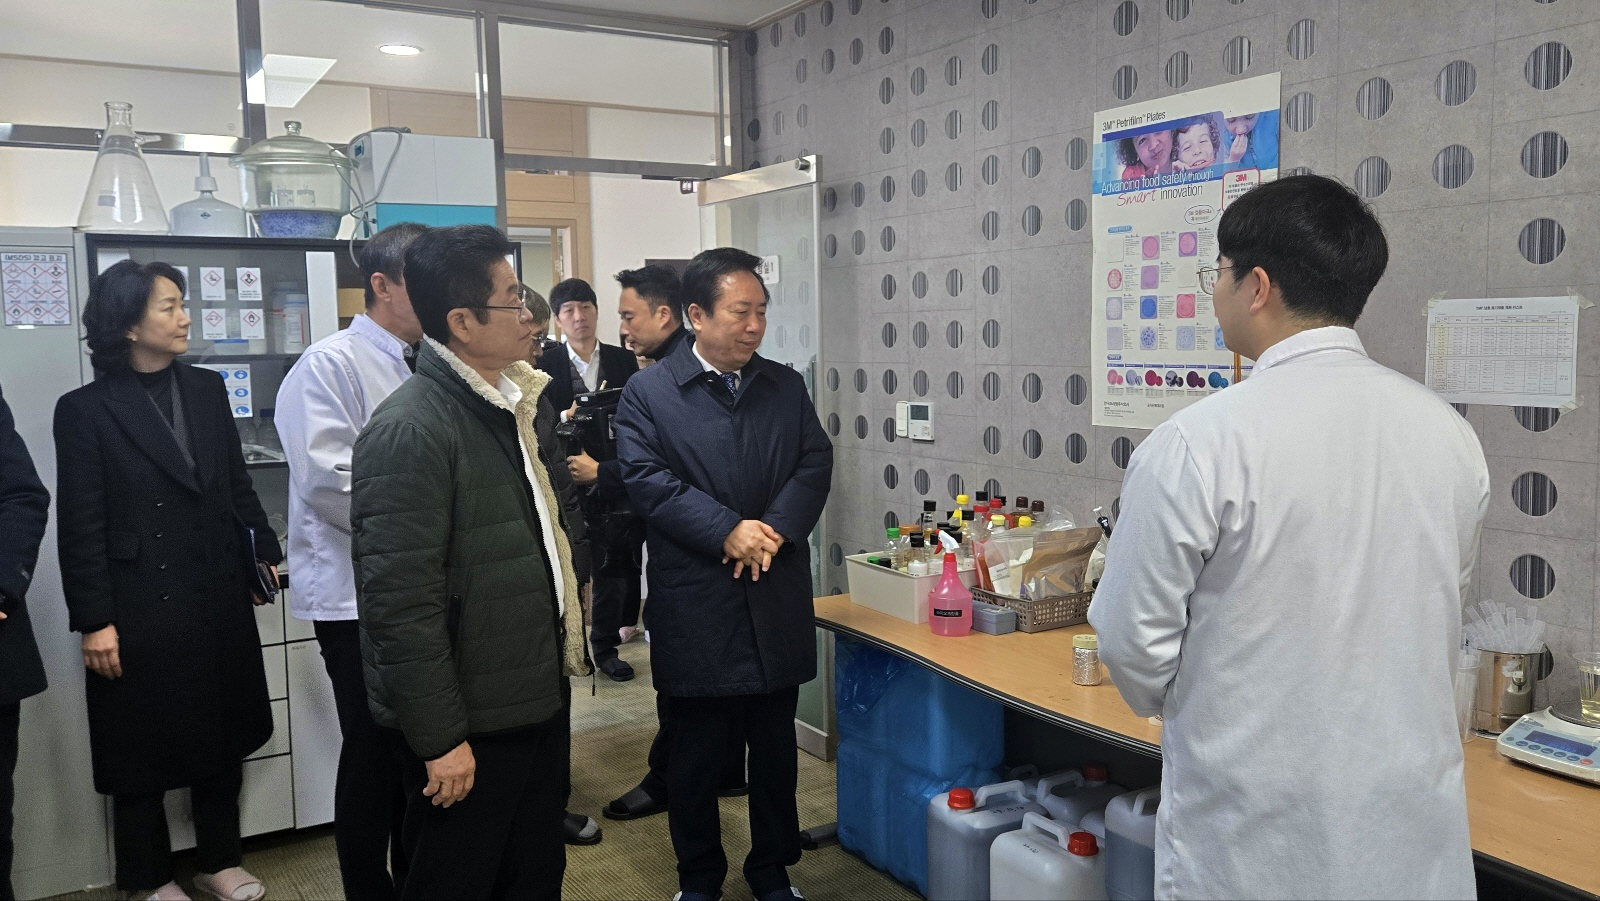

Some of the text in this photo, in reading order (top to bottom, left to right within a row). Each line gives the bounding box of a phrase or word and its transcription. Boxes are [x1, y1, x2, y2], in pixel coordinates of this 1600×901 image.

[1146, 111, 1166, 122] Plates
[1101, 169, 1214, 194] Advancing food safety through
[1235, 173, 1247, 182] 3M
[1160, 184, 1203, 200] innovation
